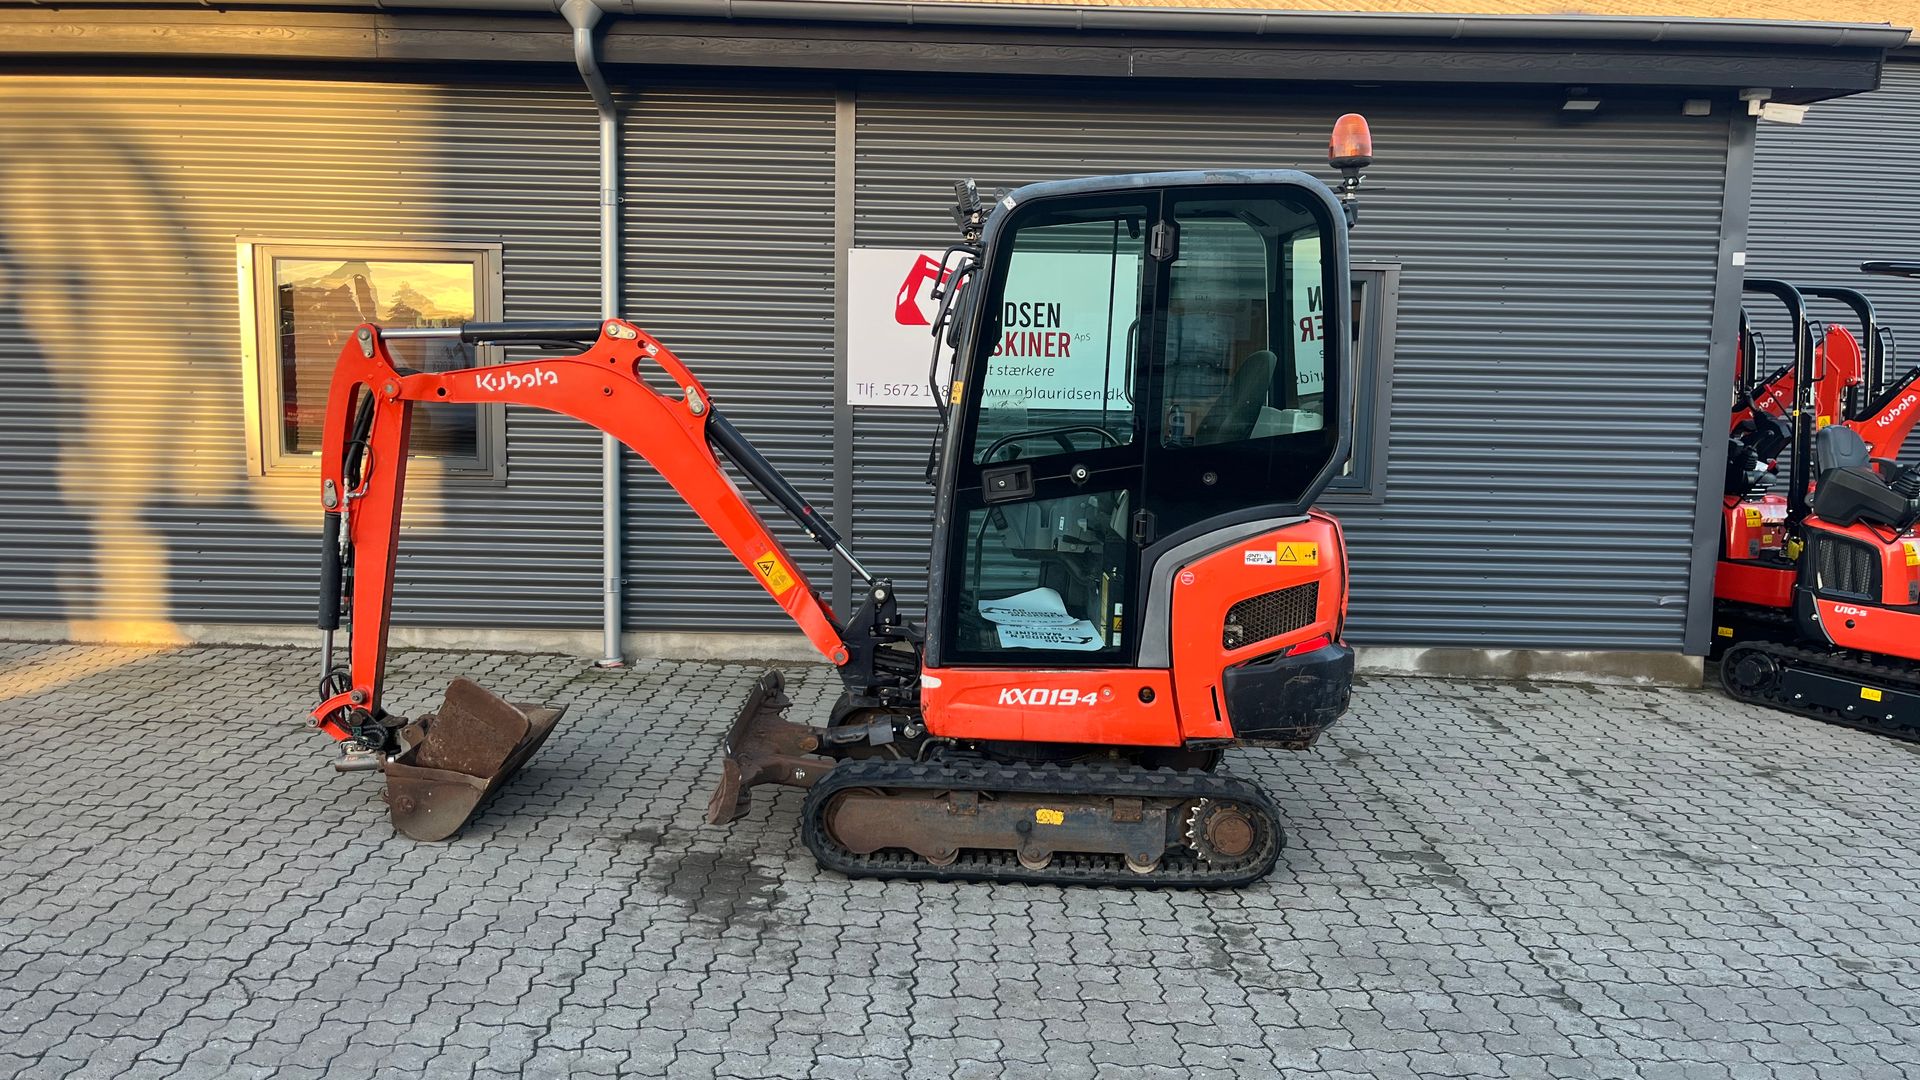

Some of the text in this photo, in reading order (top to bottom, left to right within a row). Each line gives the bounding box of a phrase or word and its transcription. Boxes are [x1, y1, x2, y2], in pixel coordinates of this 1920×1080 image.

[1004, 301, 1061, 328] DSEN
[1074, 333, 1091, 342] ApS
[475, 367, 559, 392] Kubota
[997, 365, 1055, 377] stærkere
[856, 383, 878, 398] Tlf.
[883, 384, 919, 397] 5672
[1876, 394, 1917, 428] Kubota
[998, 688, 1098, 706] KX019-4
